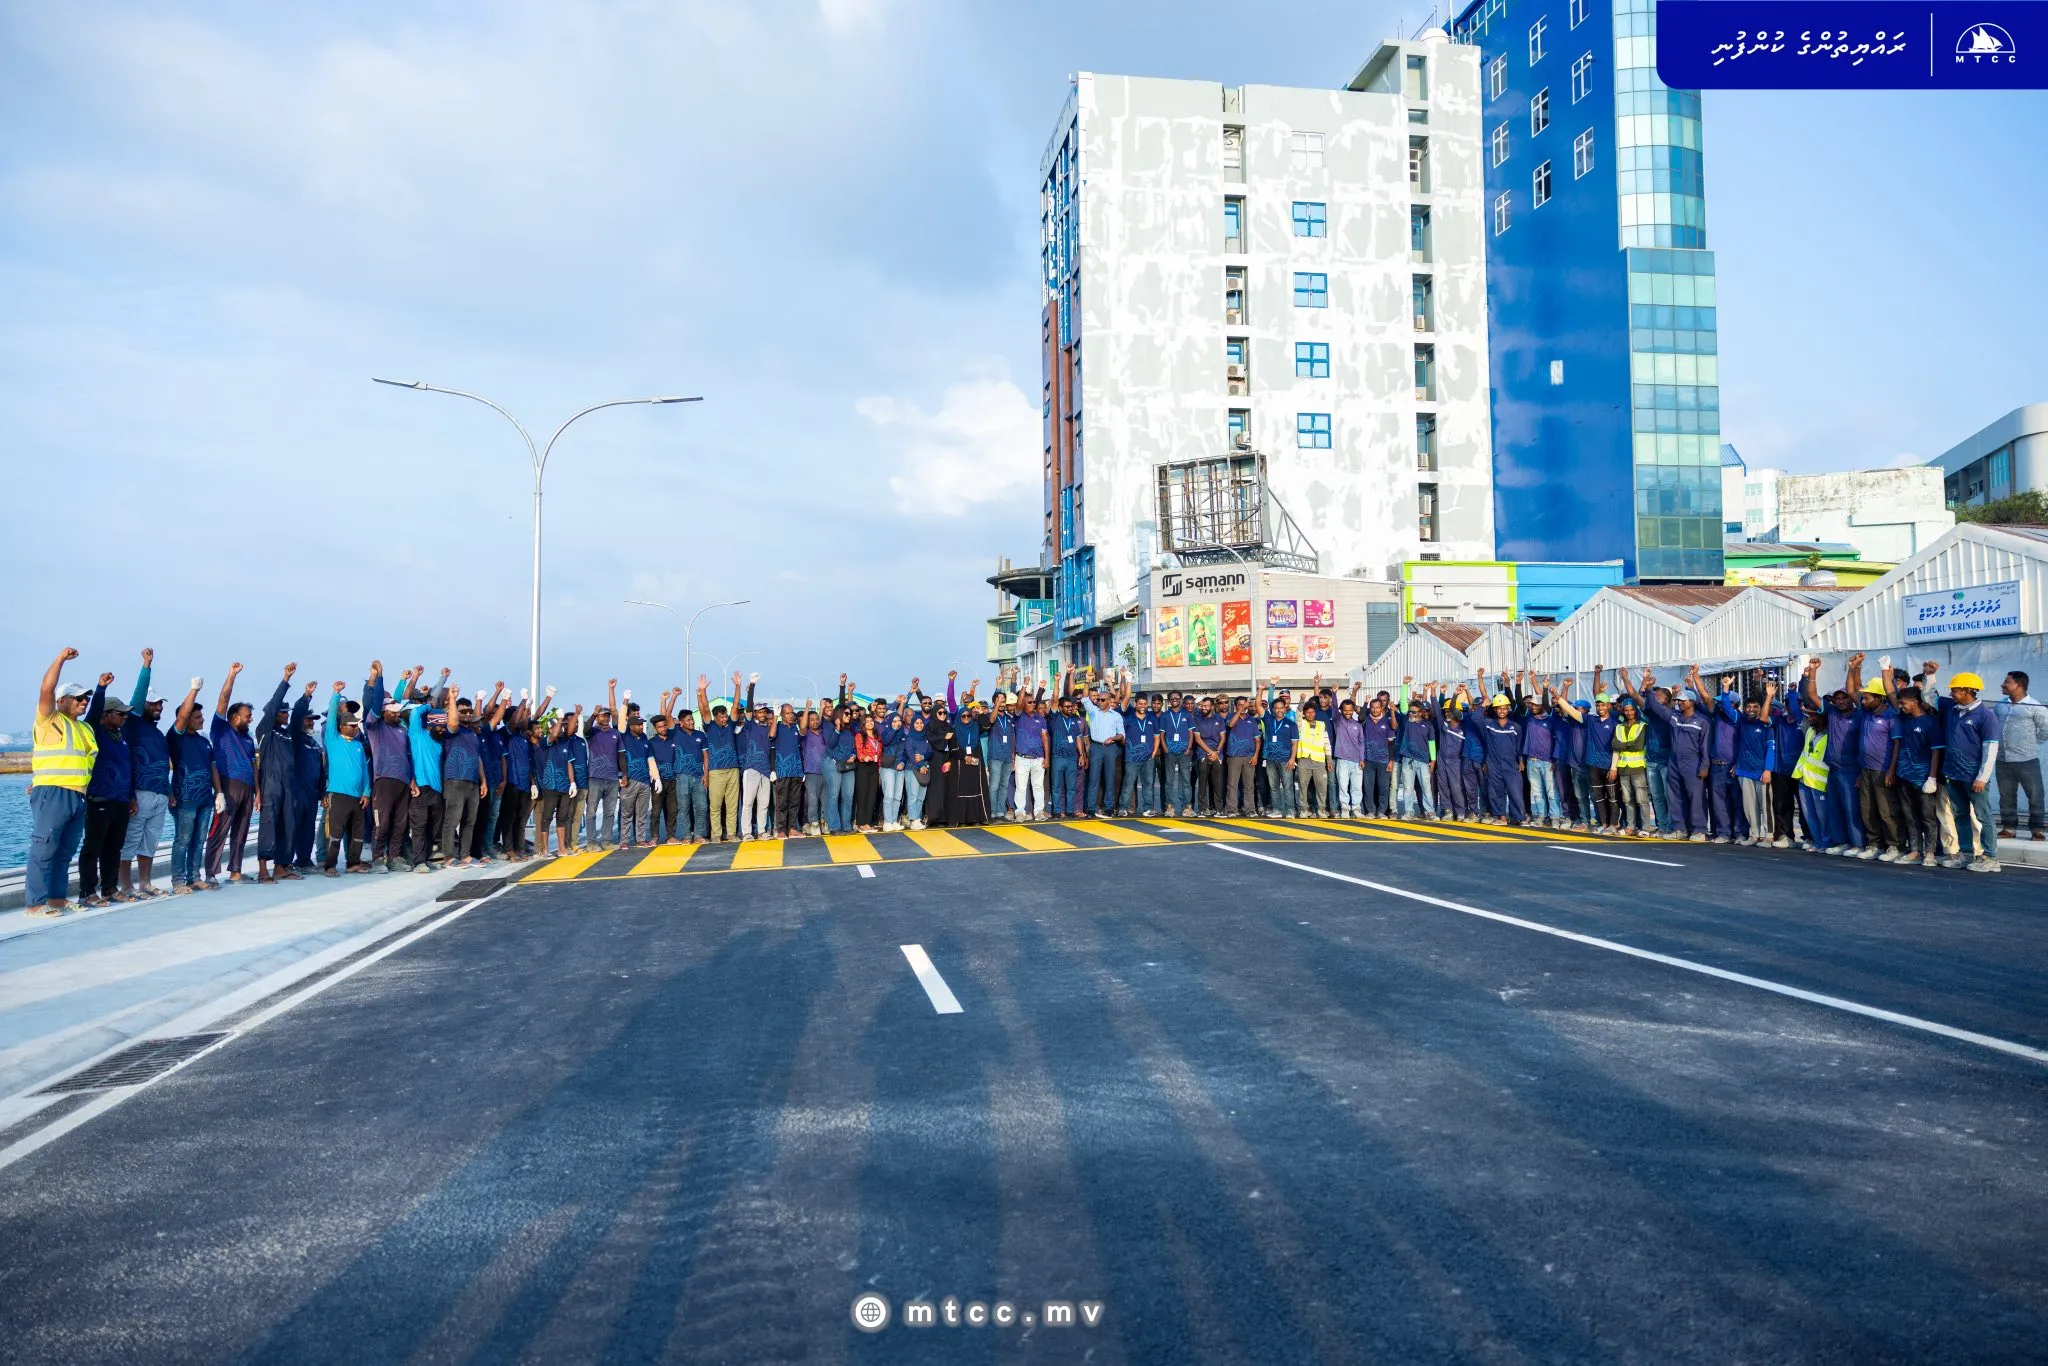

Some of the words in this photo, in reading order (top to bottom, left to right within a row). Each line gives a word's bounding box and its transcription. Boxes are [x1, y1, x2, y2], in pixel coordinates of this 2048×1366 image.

[1185, 573, 1245, 589] samann
[1199, 586, 1235, 594] Traders
[1907, 620, 1982, 636] DHATHURUVERINGE
[1984, 616, 2017, 626] MARKET
